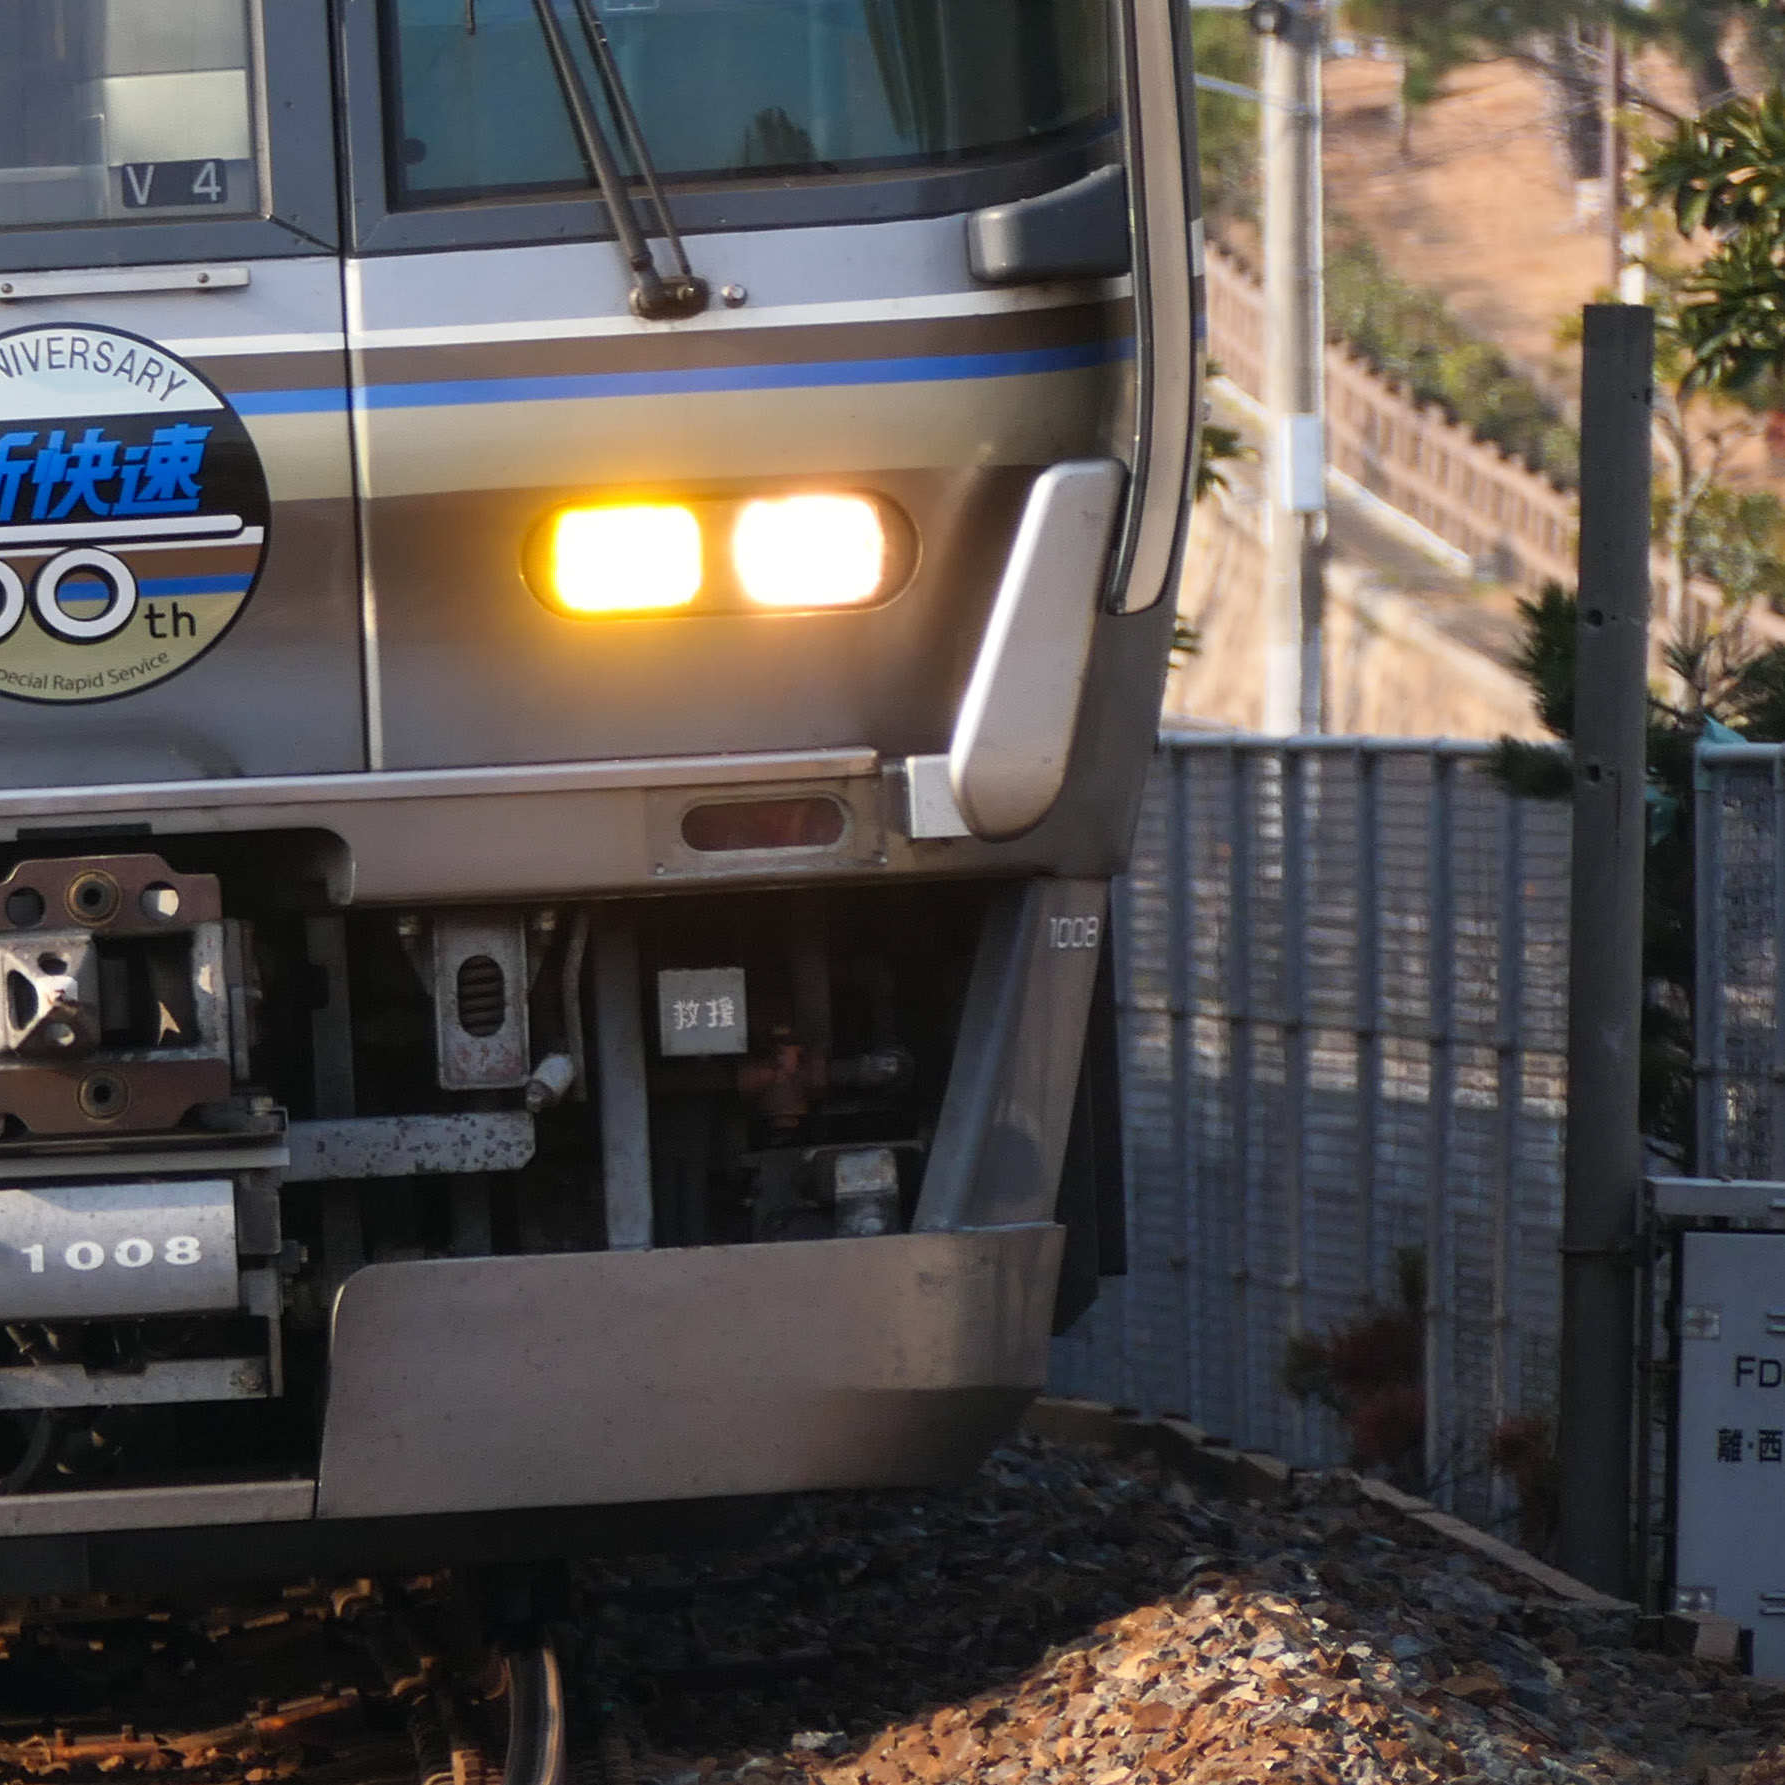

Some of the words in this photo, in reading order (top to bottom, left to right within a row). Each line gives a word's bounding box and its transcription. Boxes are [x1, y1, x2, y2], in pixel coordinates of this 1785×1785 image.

[127, 164, 156, 205] V
[192, 160, 222, 202] 4
[53, 672, 104, 694] Rapid
[108, 650, 171, 685] Service
[1048, 916, 1099, 948] 1008
[21, 1235, 203, 1274] 1008
[1735, 1355, 1785, 1388] FD
